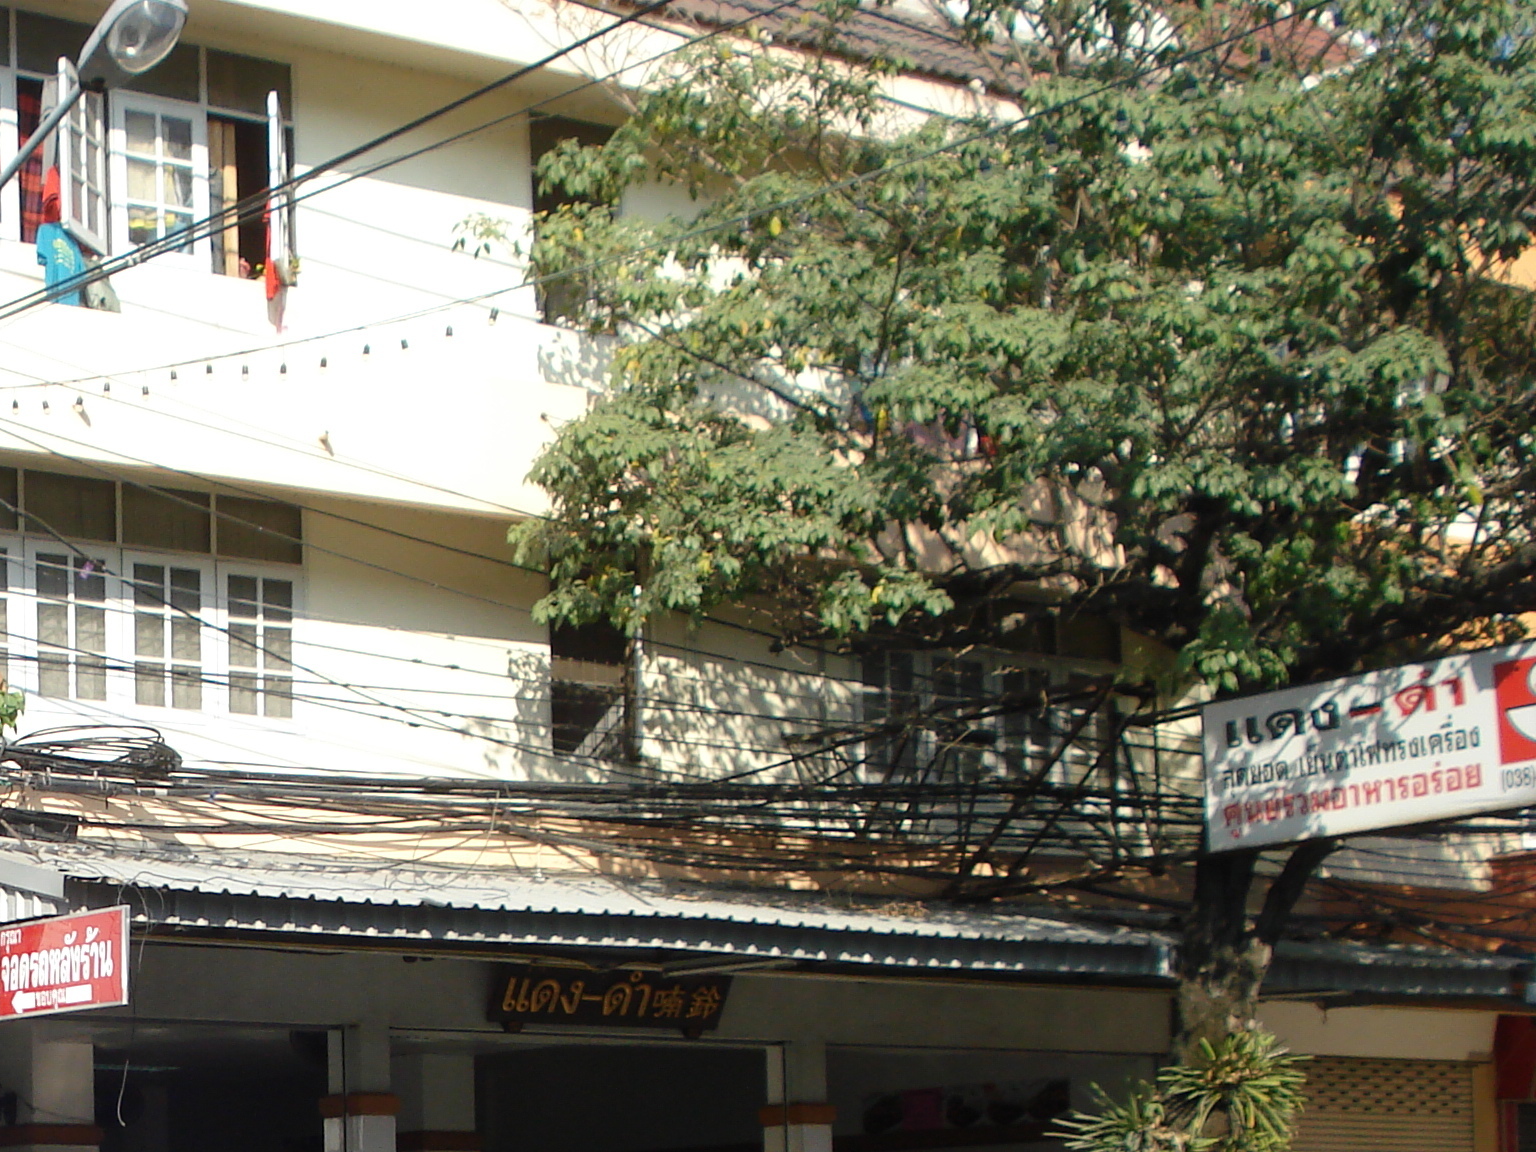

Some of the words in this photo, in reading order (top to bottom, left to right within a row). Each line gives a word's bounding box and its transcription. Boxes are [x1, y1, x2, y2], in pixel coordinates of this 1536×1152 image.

[1225, 668, 1467, 748] แดง-ดำ
[0, 929, 22, 953] กรุณา
[0, 926, 114, 992] จอดรถหลังร้าน
[35, 988, 67, 1010] ขอบคุณ
[502, 971, 652, 1018] แดง-ดำ
